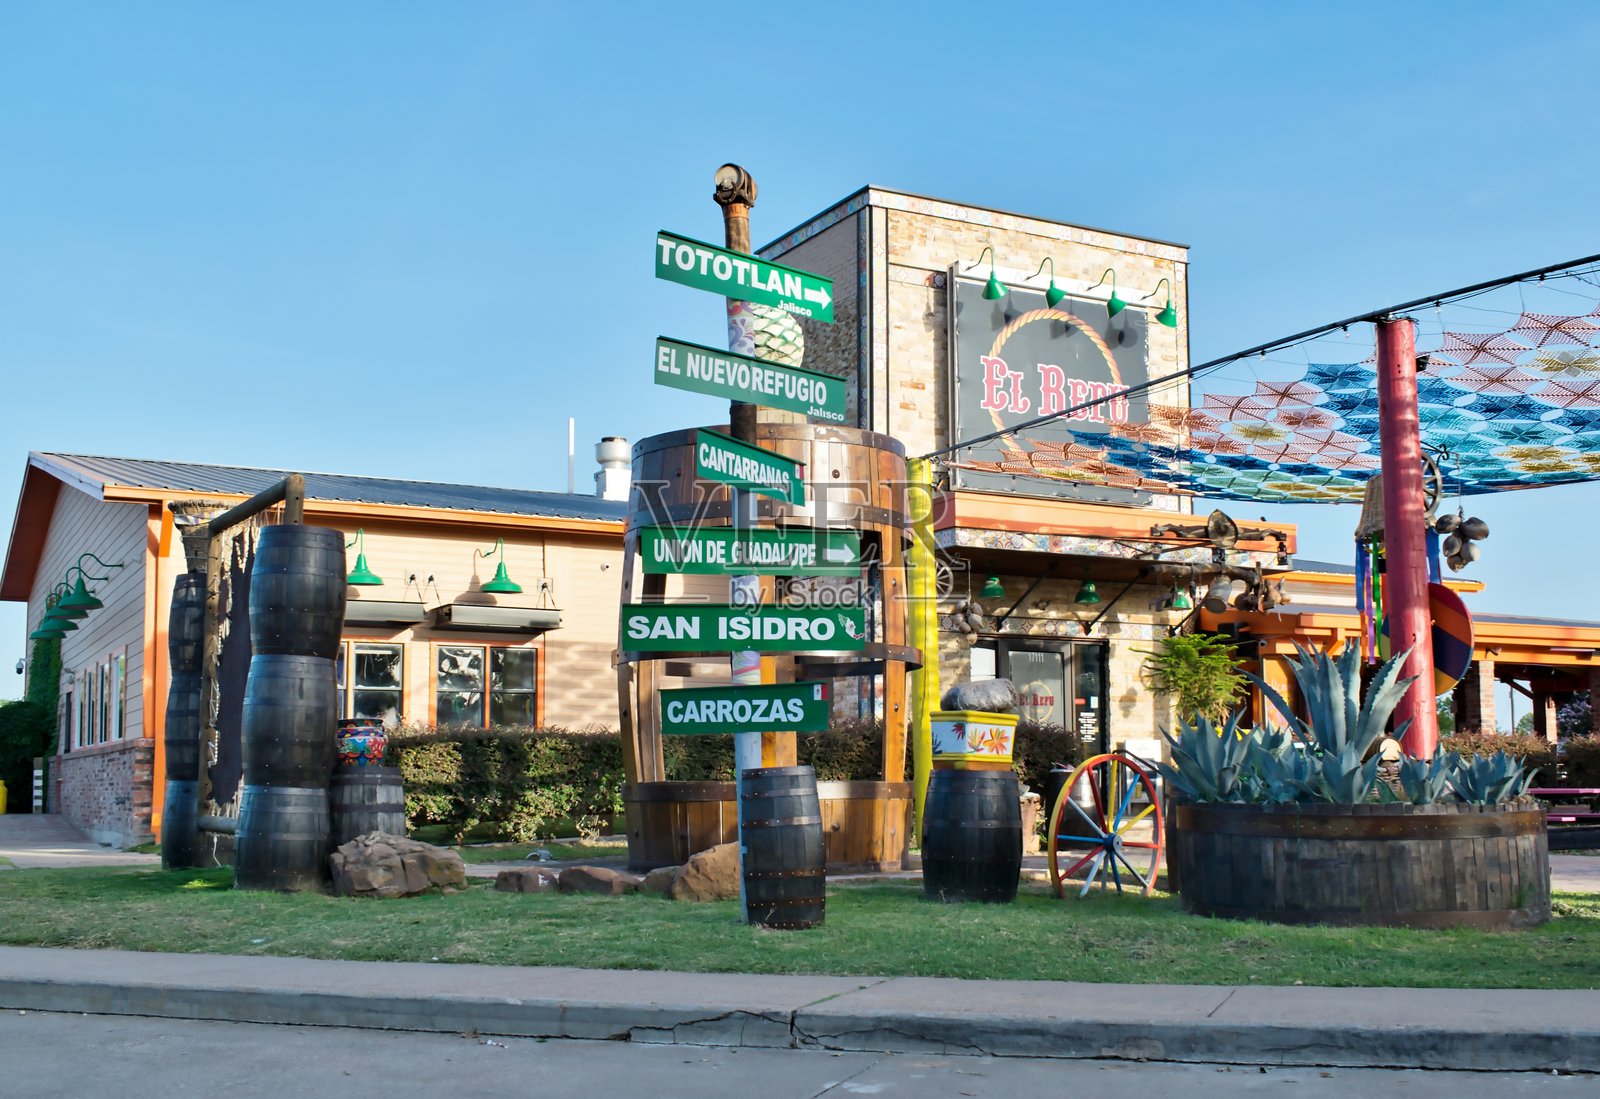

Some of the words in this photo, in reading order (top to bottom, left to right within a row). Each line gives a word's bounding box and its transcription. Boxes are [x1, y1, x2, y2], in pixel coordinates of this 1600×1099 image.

[658, 238, 802, 300] TOTOTLAN
[777, 300, 812, 317] Jalisco
[657, 346, 681, 375] EL
[807, 406, 845, 421] Jalisco
[699, 442, 790, 493] CANTARRANAS
[653, 538, 702, 564] UNION
[706, 540, 726, 564] DE
[731, 541, 817, 566] GUADALUPE
[627, 615, 700, 640] SAN
[718, 616, 836, 641] ISIDRO
[666, 697, 804, 724] CARROZAS
